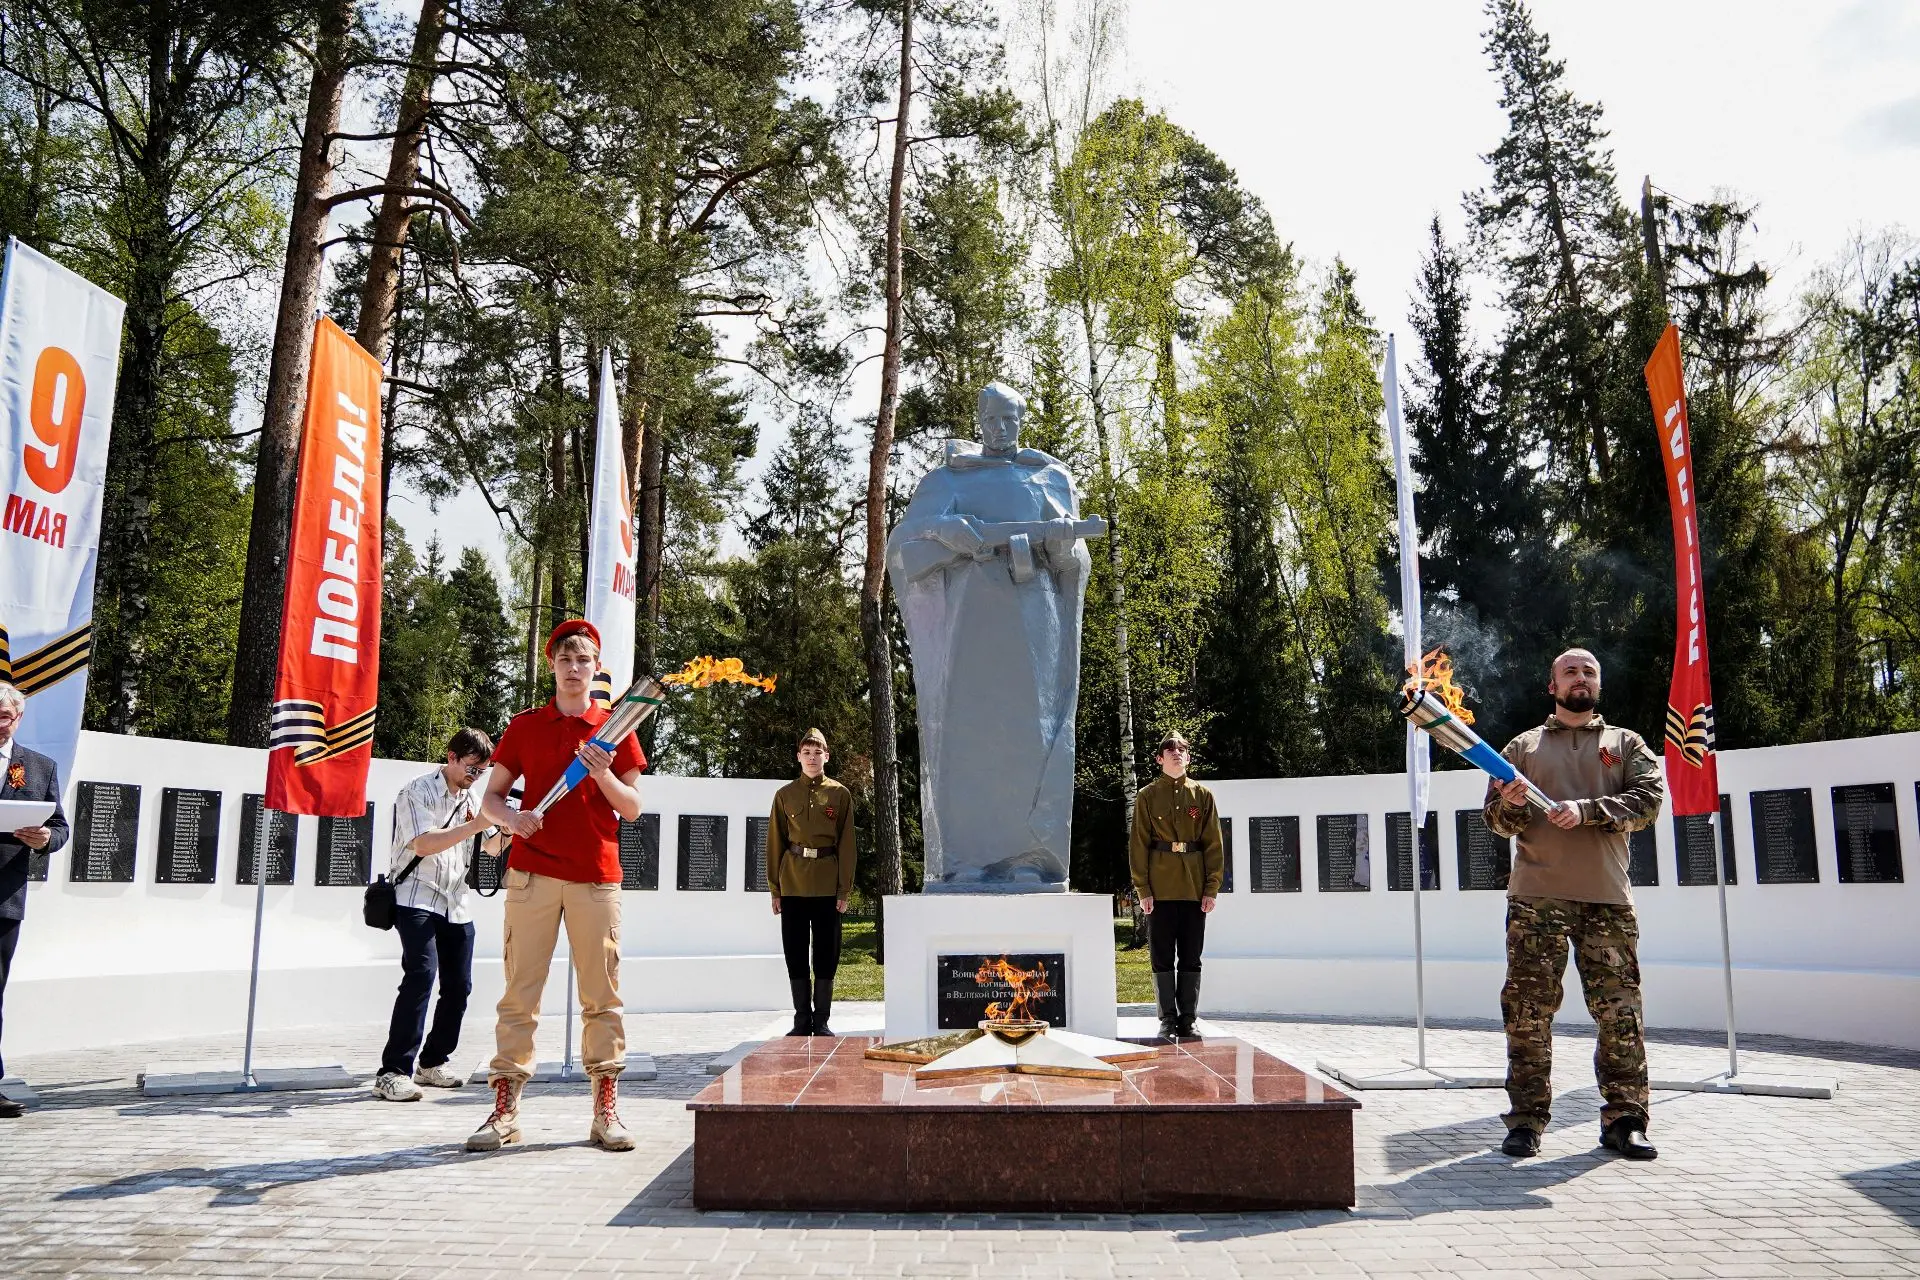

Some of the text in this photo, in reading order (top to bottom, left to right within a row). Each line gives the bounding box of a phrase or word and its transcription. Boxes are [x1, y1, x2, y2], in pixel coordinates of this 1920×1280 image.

[24, 346, 87, 495] 9
[2, 493, 68, 550] МАЯ
[310, 391, 368, 665] ПОБЕДА!
